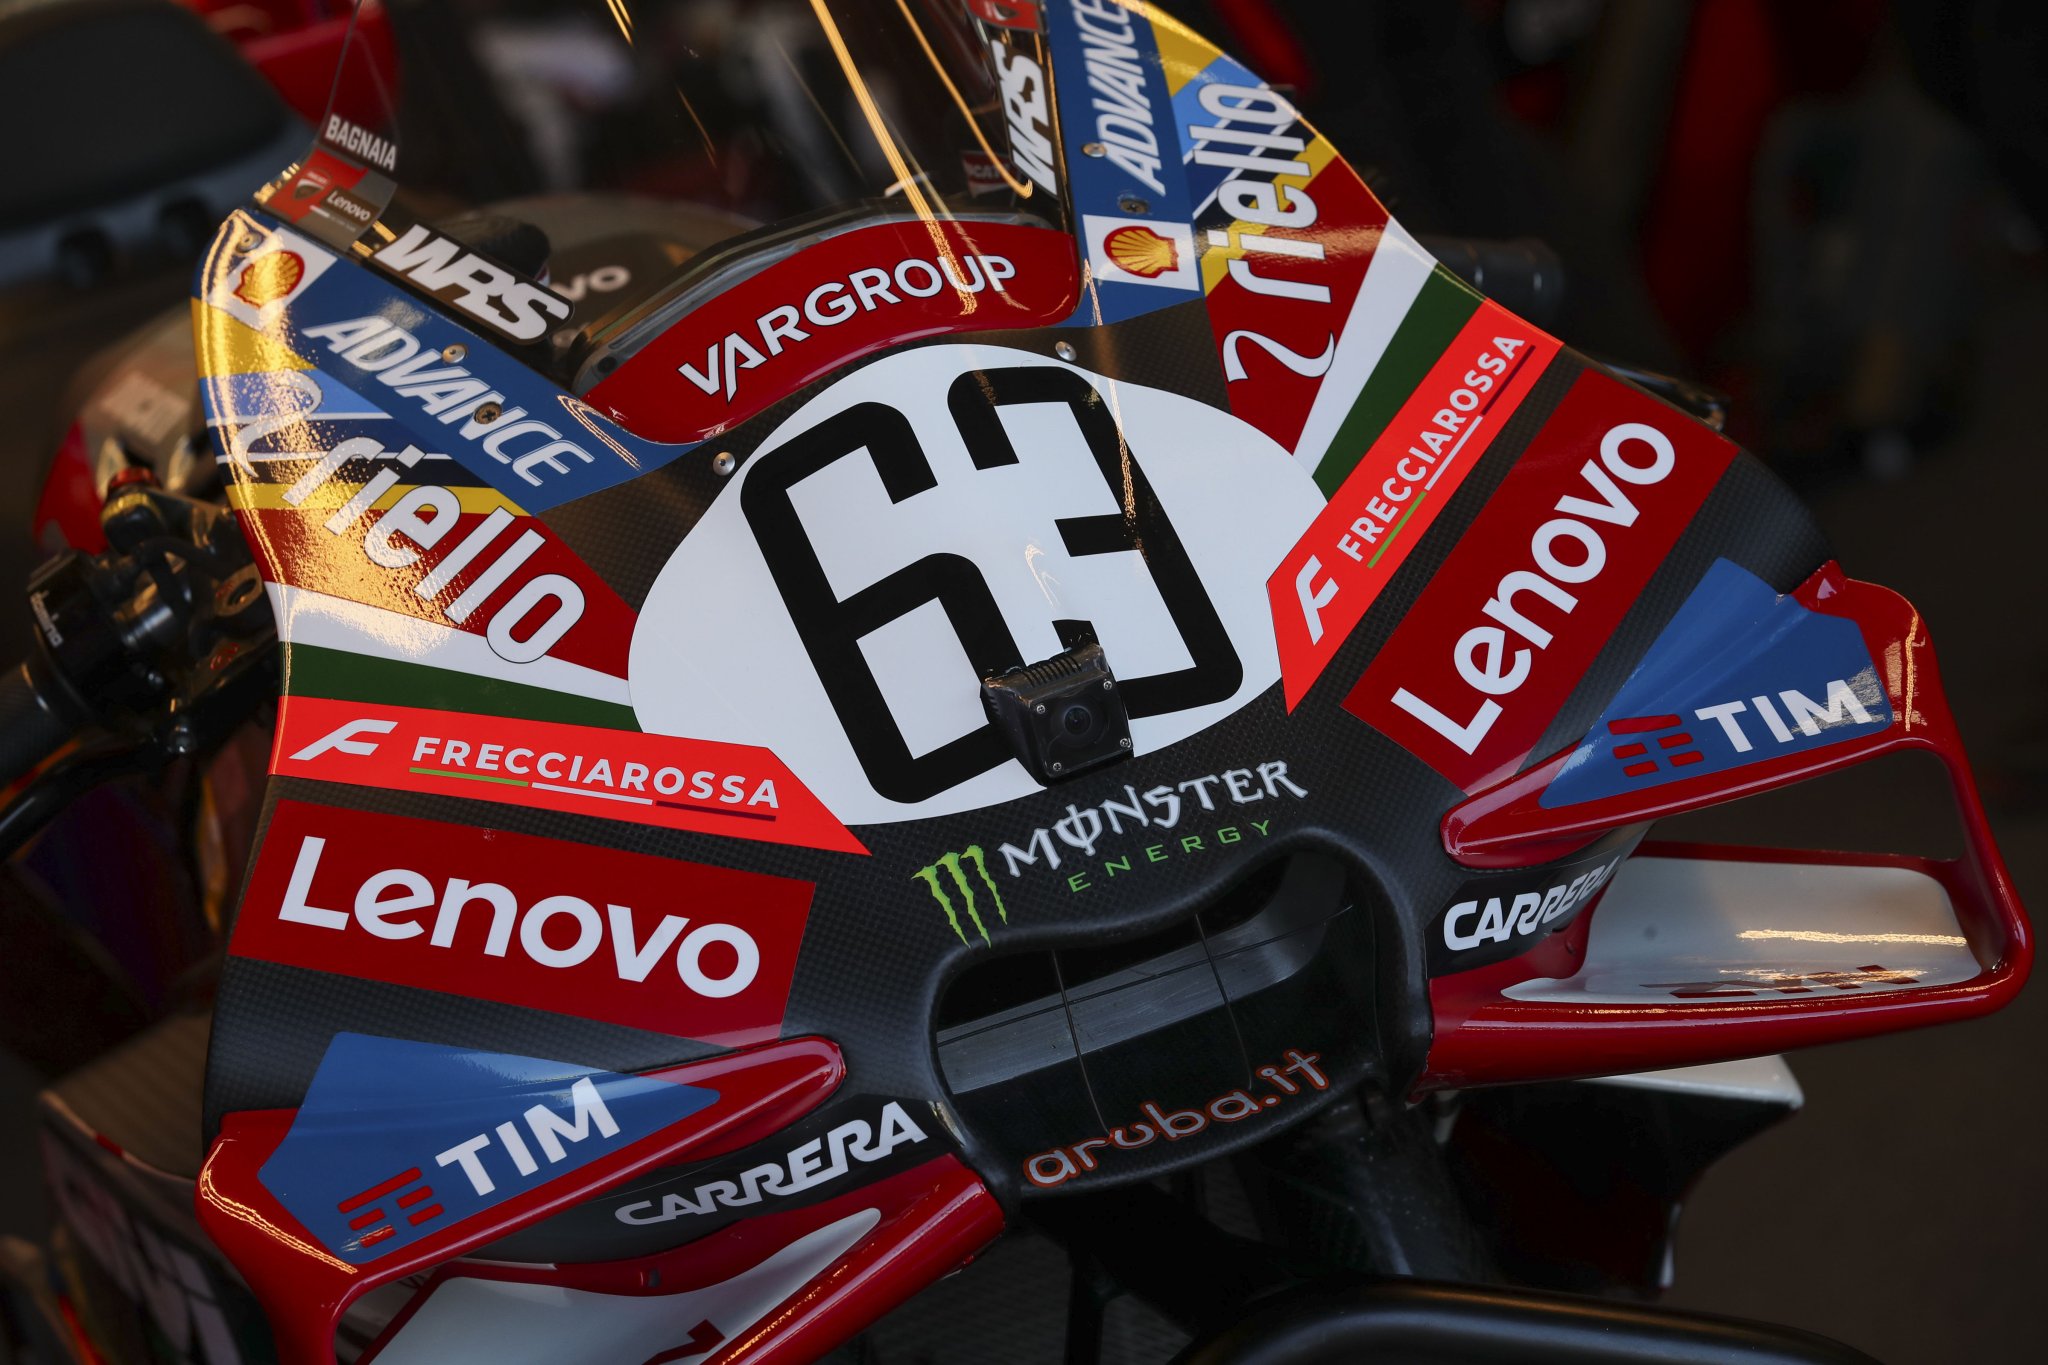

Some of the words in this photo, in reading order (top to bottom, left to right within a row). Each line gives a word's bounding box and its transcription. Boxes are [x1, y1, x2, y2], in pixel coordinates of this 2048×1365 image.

[325, 113, 398, 172] BAGNAIA
[990, 39, 1058, 196] WRS
[326, 189, 371, 221] Lenovo
[1189, 82, 1332, 304] riello
[373, 223, 570, 340] WRS
[677, 255, 1017, 401] VARGROUP
[301, 315, 595, 488] ADVANCE
[1337, 336, 1525, 560] FRECCIAROSSA
[281, 436, 586, 664] riello
[740, 365, 1243, 804] 63
[1390, 422, 1676, 757] Lenovo
[411, 735, 779, 812] FRECCIAROSSA
[1694, 678, 1878, 753] TIM
[278, 835, 760, 999] Lenovo
[1066, 819, 1272, 893] ENERGY
[1442, 858, 1617, 952] CARRERA
[435, 1077, 621, 1196] TIM
[614, 1100, 929, 1226] CARRERA
[1022, 1048, 1330, 1189] aruba.it
